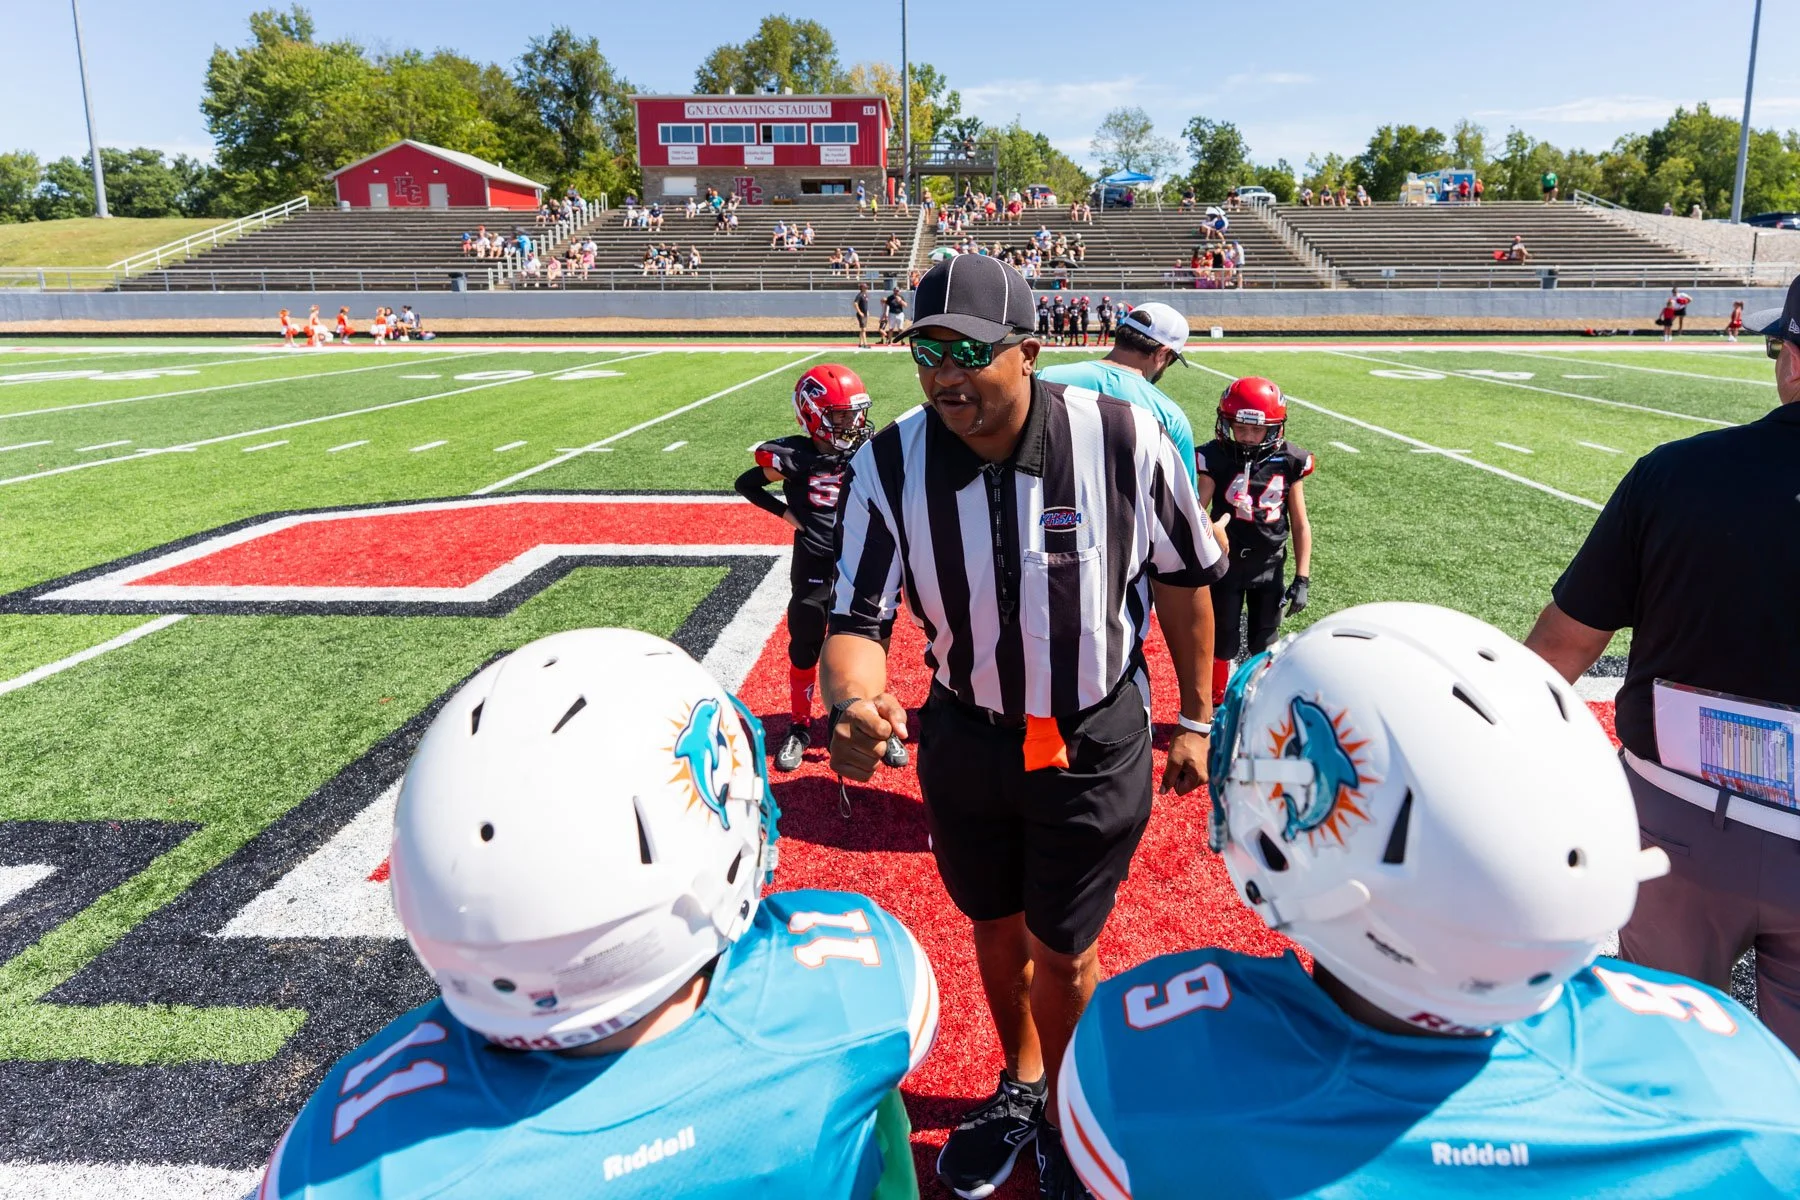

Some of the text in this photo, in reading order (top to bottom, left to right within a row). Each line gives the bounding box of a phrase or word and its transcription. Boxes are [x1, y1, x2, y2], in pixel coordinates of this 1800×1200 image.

[687, 103, 829, 116] GN EXCAVATING STADIUM
[1038, 511, 1083, 527] KHSAA
[786, 908, 881, 969] 11
[1122, 962, 1232, 1031] 9
[602, 1125, 696, 1181] Riddell
[1430, 1141, 1529, 1167] Riddell
